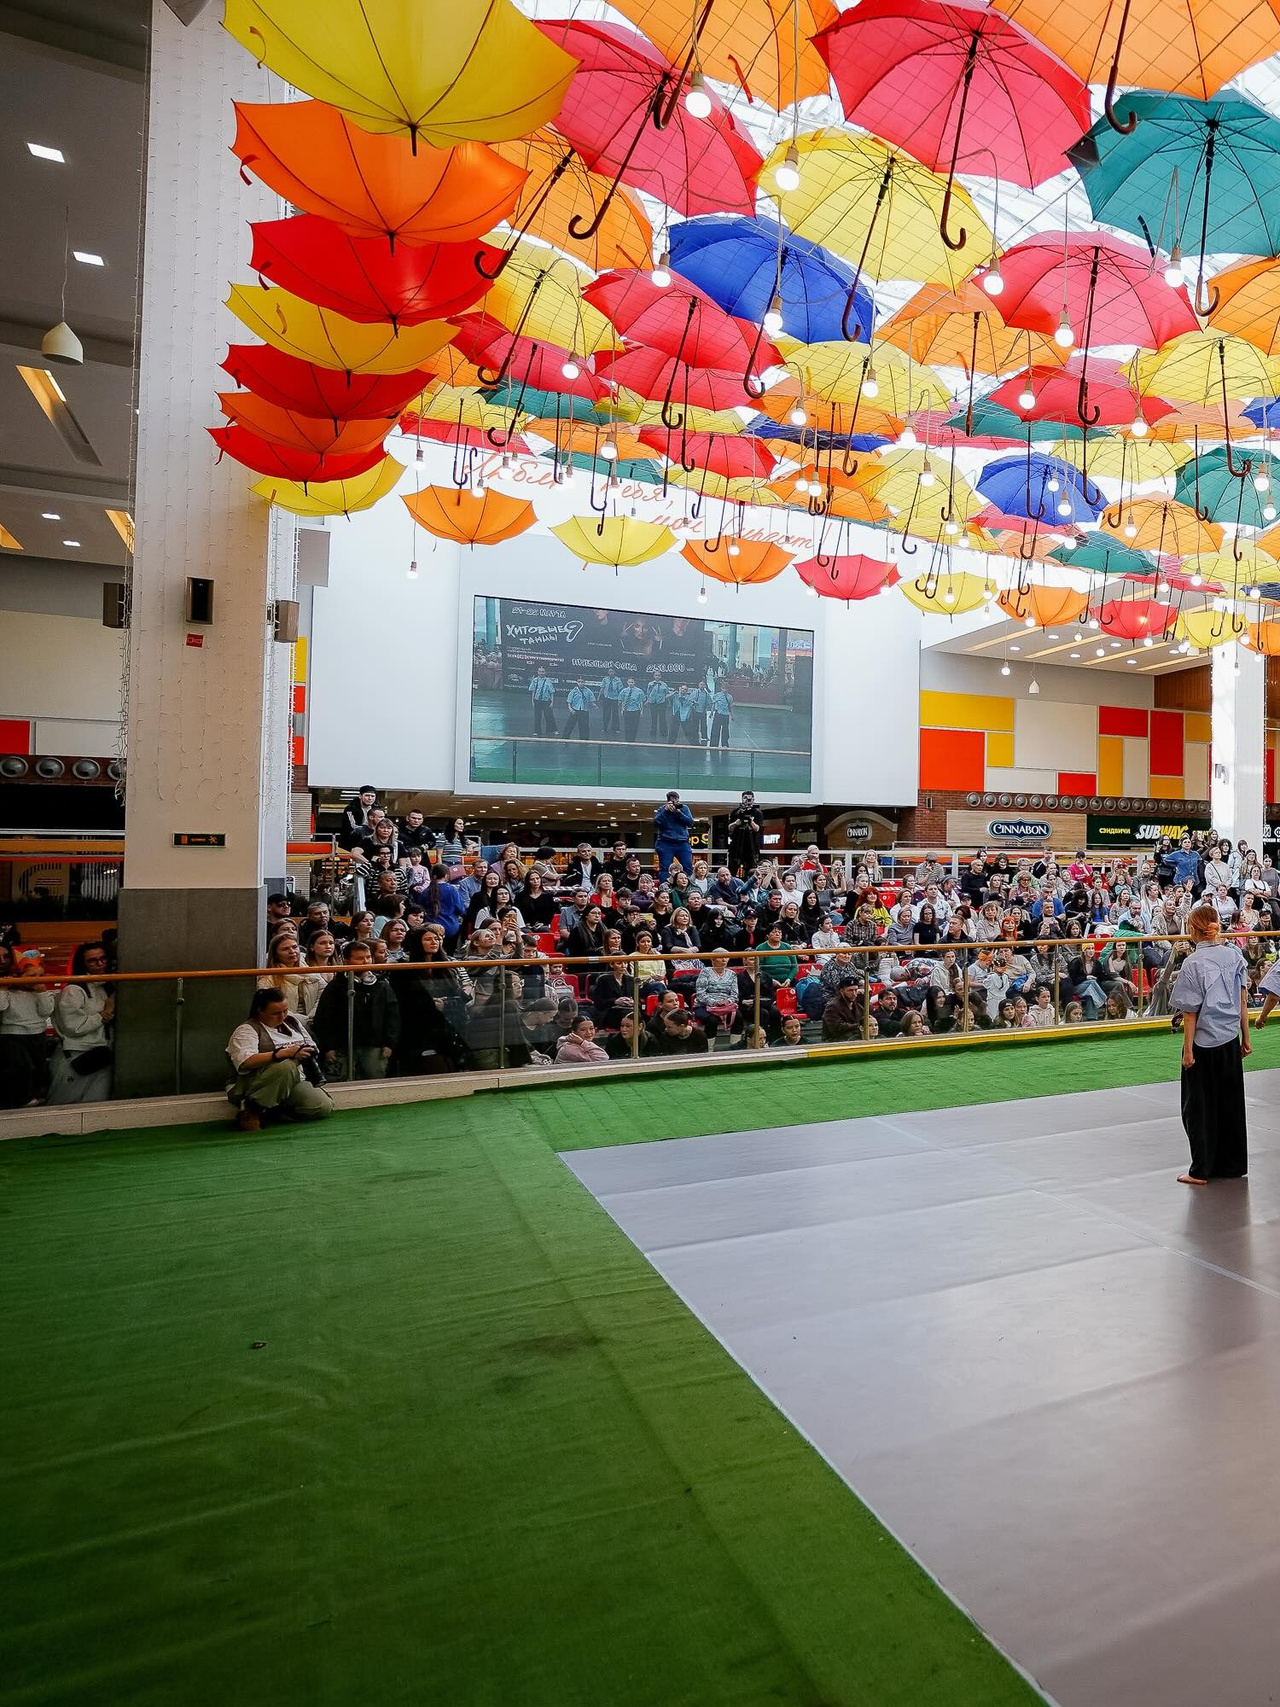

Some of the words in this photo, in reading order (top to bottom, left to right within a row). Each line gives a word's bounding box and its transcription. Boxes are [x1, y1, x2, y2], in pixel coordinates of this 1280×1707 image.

[506, 624, 565, 638] ХИТОВЫЕ
[993, 823, 1048, 835] CINNABON
[1099, 827, 1131, 835] СЭНДВИЧИ
[1135, 824, 1188, 840] SUBWAY
